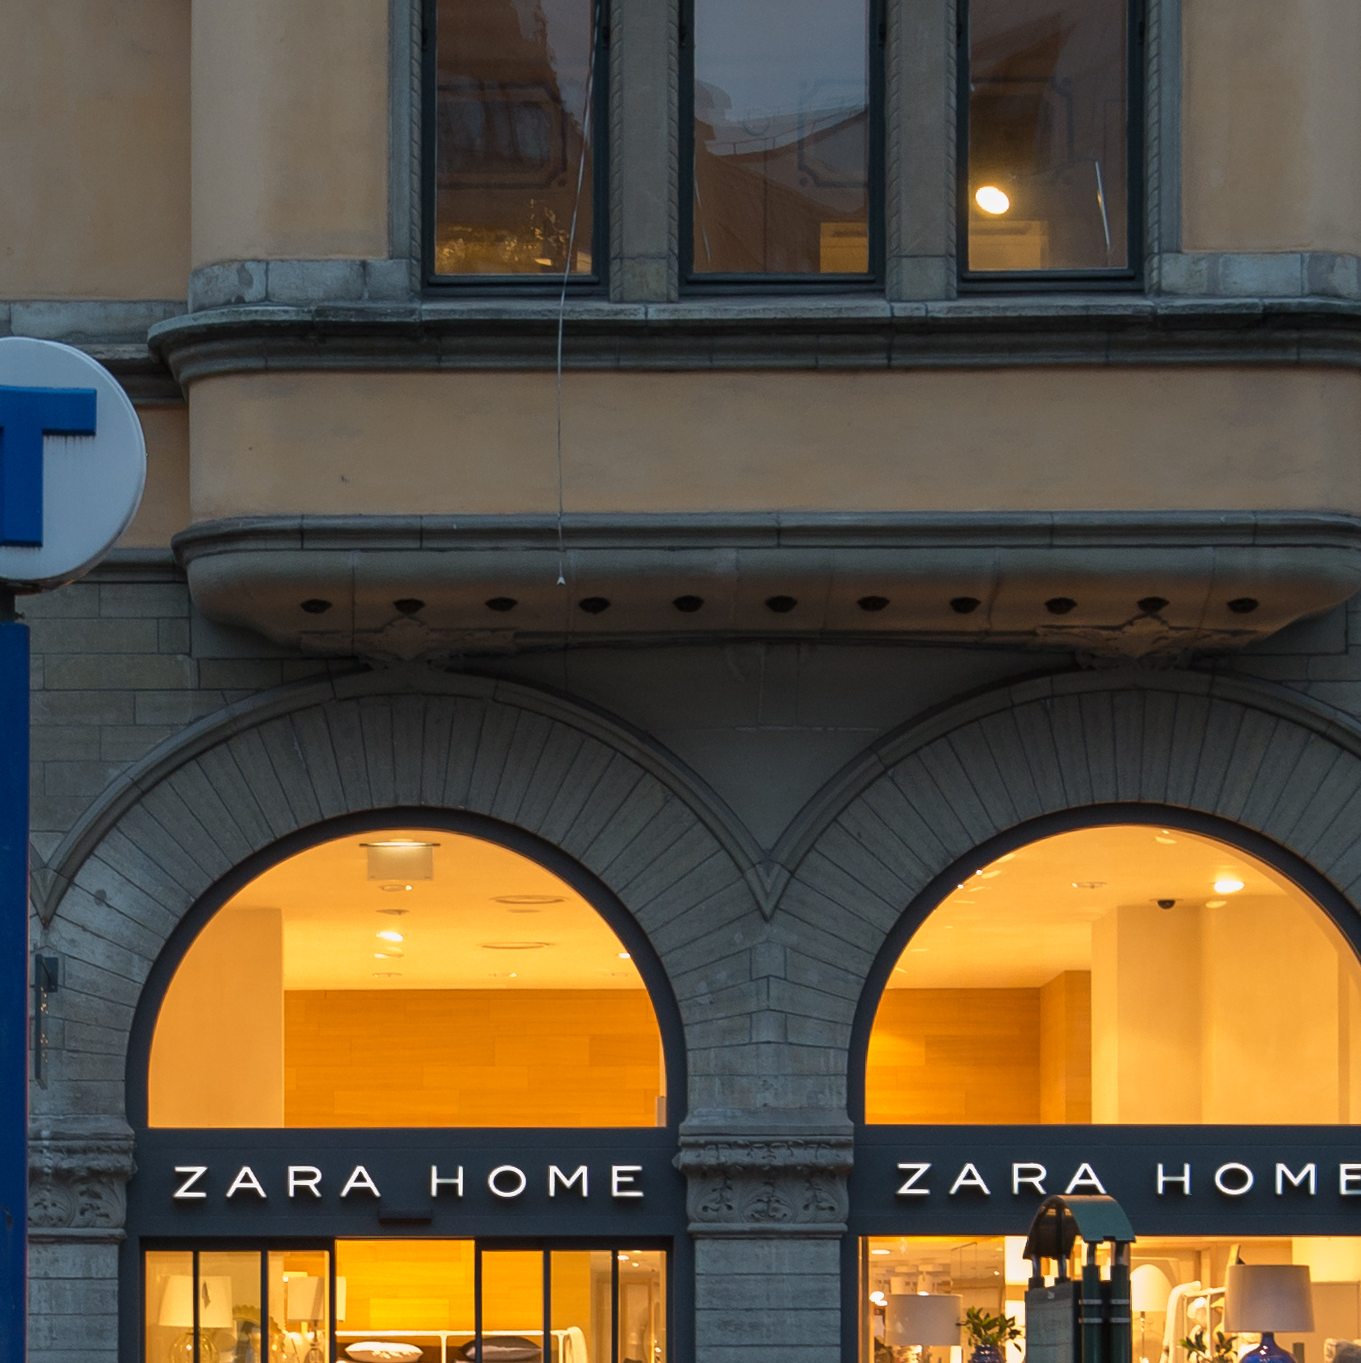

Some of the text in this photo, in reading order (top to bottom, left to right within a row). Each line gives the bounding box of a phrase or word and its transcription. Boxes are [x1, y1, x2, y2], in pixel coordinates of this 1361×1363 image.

[173, 1164, 644, 1199] ZARA HOME
[897, 1162, 1107, 1196] ZARA
